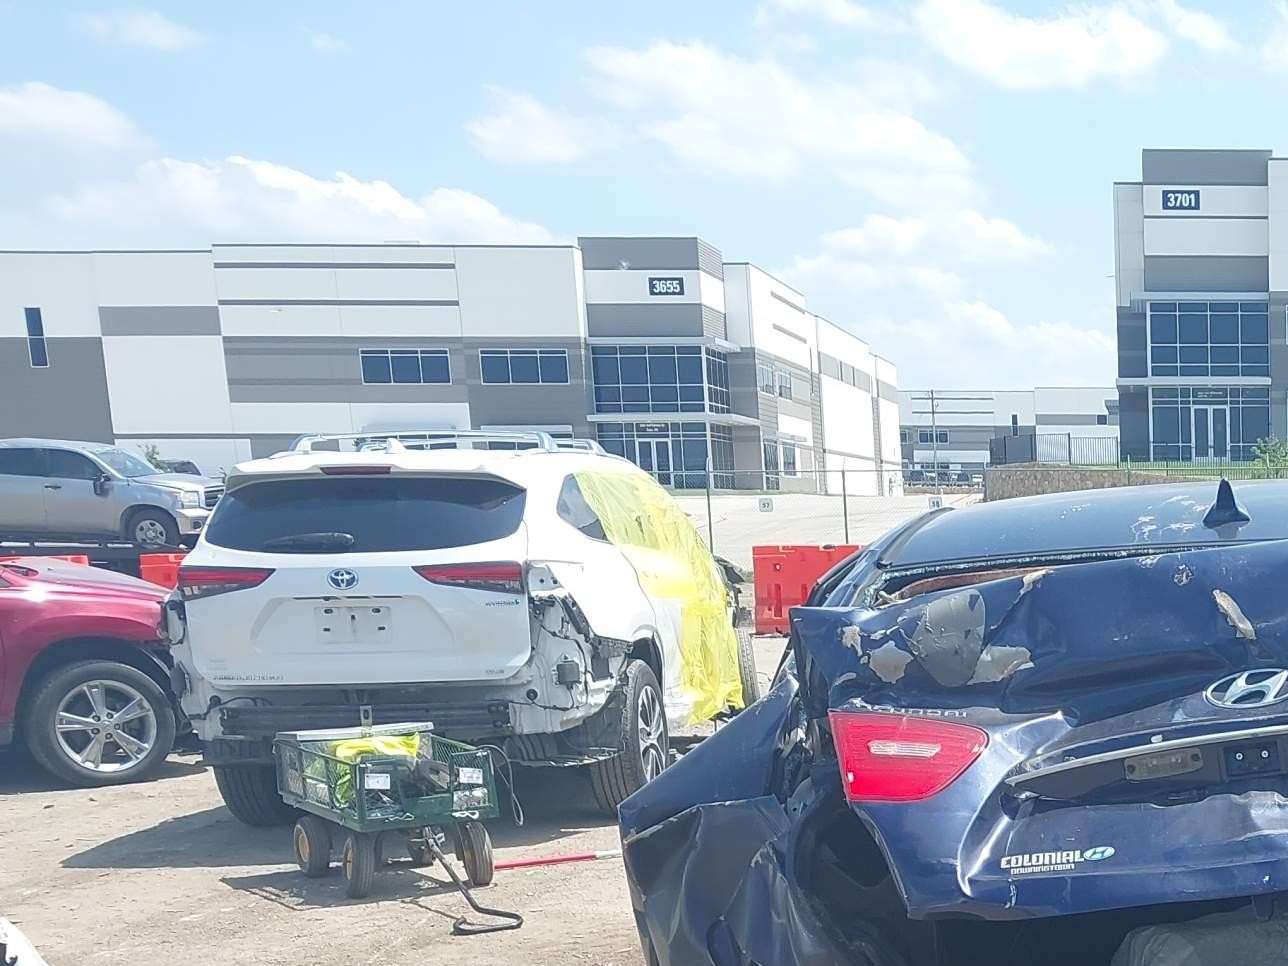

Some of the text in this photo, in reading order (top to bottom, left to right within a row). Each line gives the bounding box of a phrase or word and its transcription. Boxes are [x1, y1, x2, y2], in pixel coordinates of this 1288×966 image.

[1167, 193, 1195, 207] 3701
[652, 280, 680, 293] 3655
[1000, 850, 1084, 869] COLONIAL
[1010, 863, 1075, 875] DOWNINGTOWN
